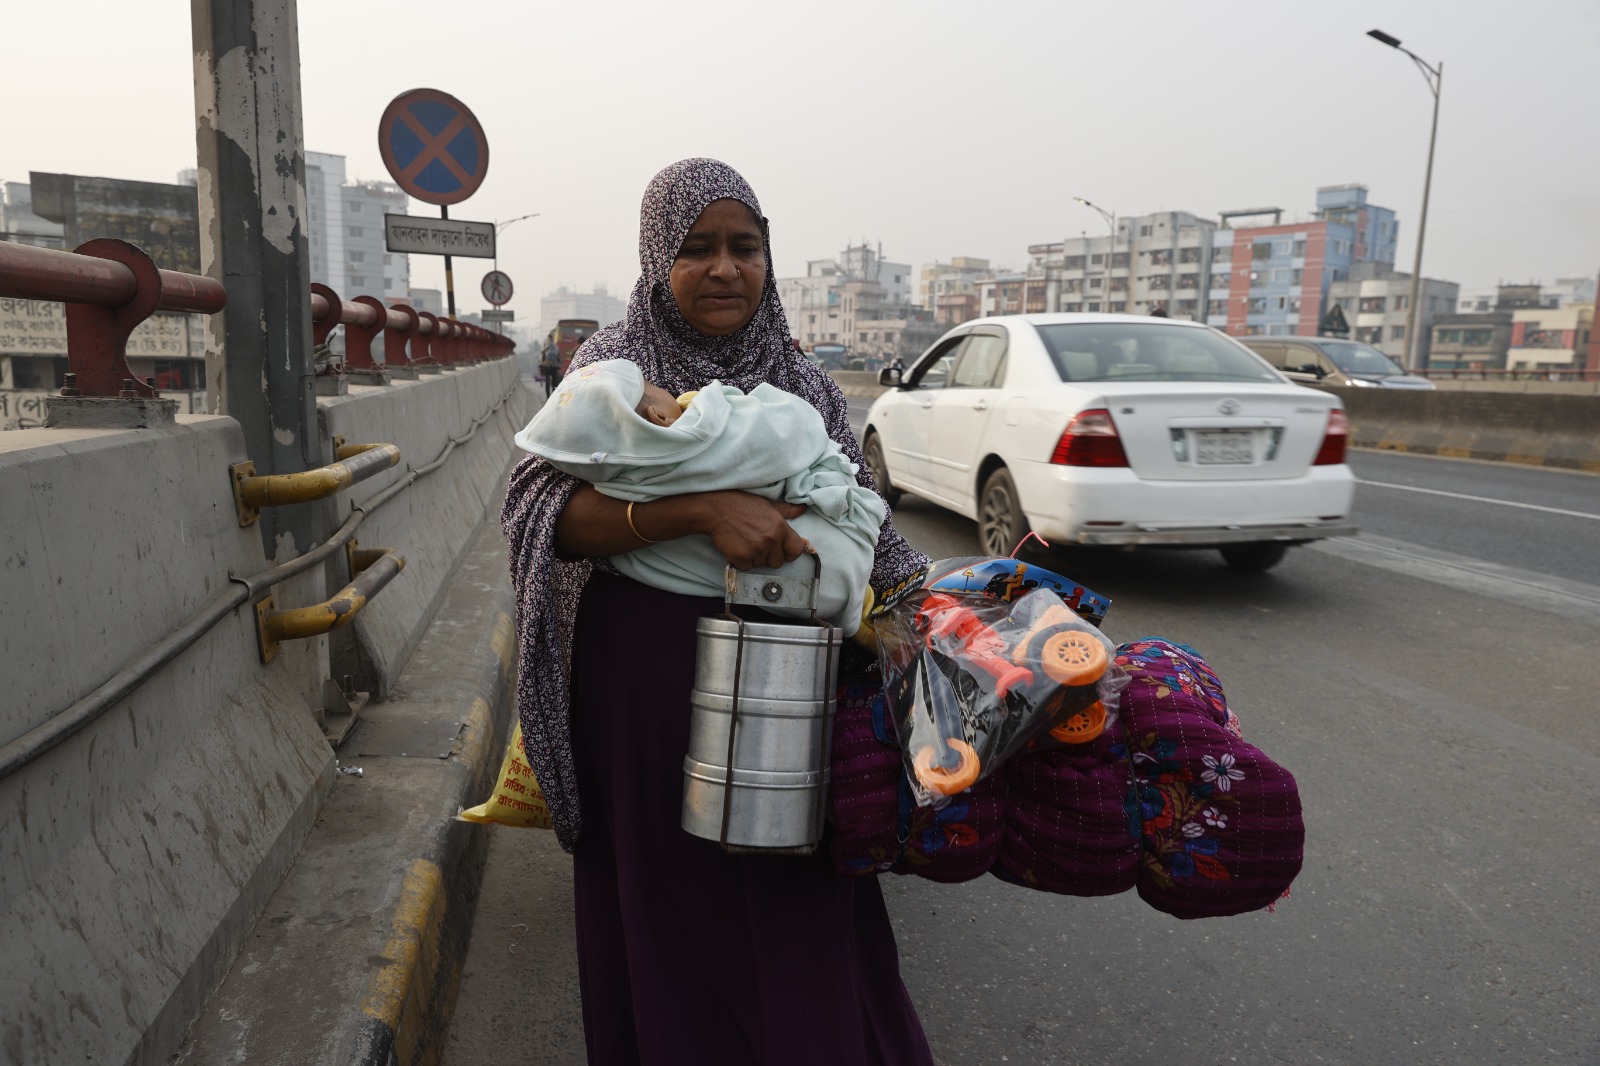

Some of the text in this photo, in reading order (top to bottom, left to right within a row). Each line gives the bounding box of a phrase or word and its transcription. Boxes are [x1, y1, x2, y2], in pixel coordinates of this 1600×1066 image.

[391, 225, 429, 246] যানবাহন
[465, 226, 490, 248] নিষেধ
[0, 298, 66, 318] অপারেশ
[498, 794, 543, 815] বাংলাদেশ
